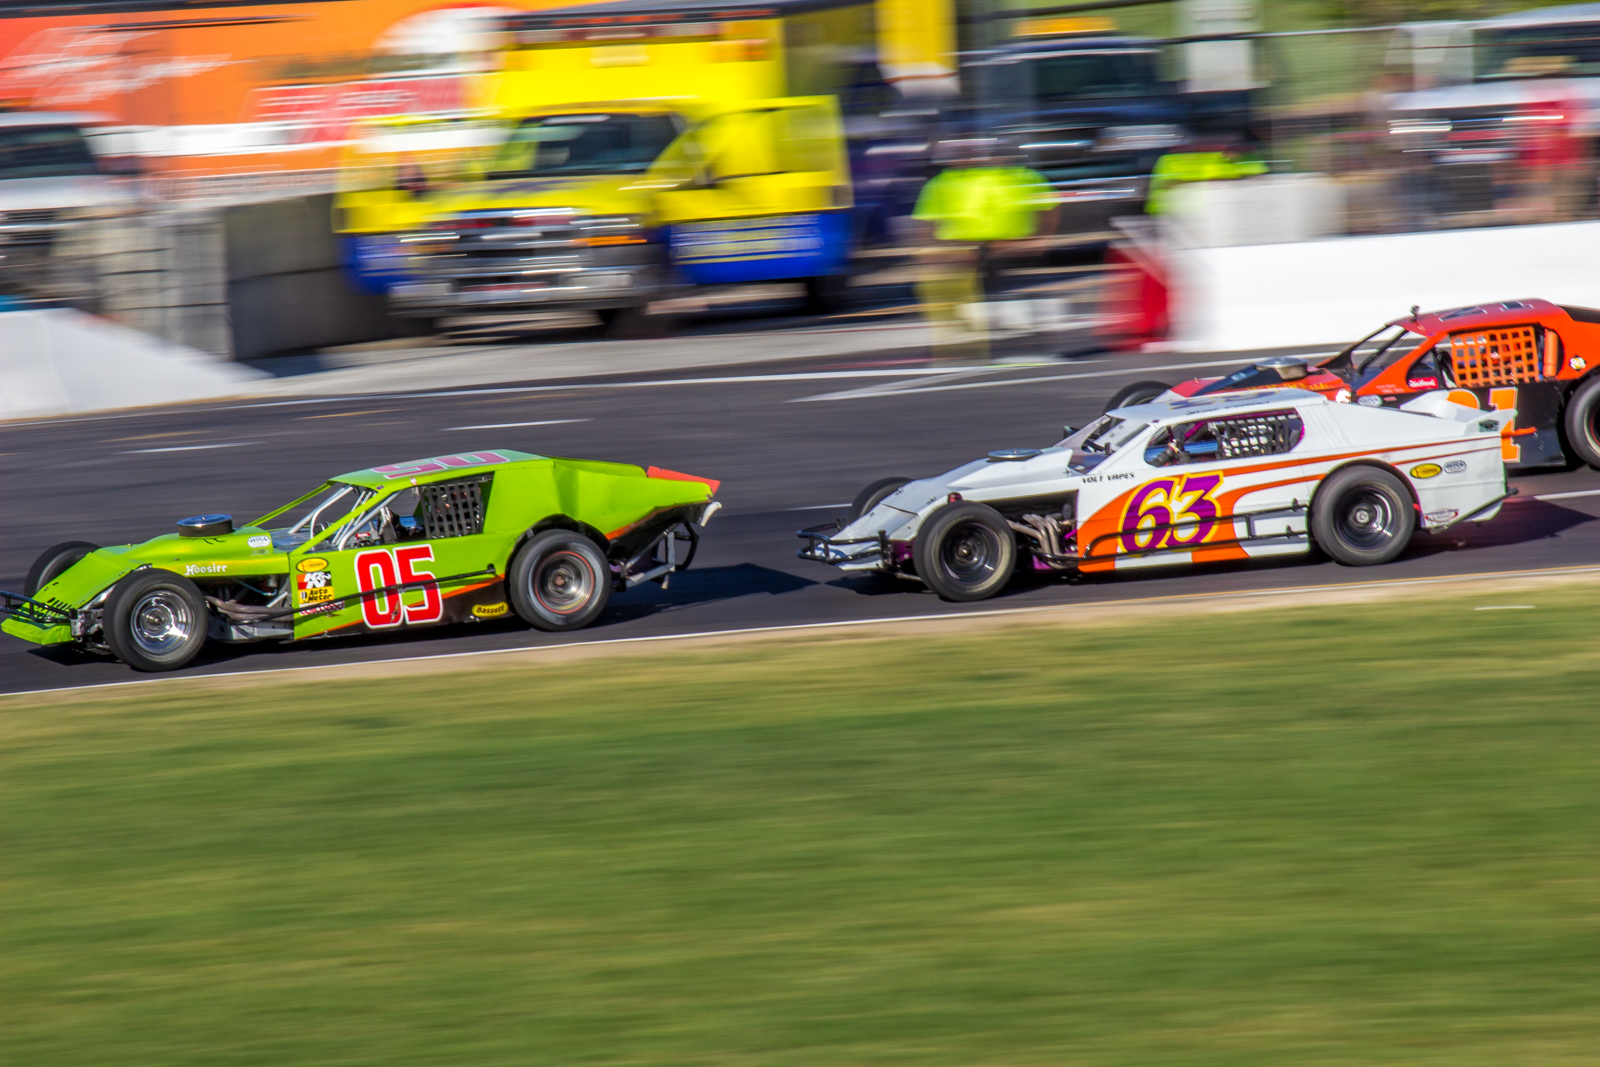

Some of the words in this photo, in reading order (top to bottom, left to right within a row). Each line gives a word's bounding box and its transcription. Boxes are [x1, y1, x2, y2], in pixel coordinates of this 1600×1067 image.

[1117, 470, 1224, 559] 63
[184, 563, 227, 576] Hoosier
[309, 588, 328, 596] Auto
[354, 543, 443, 629] 05
